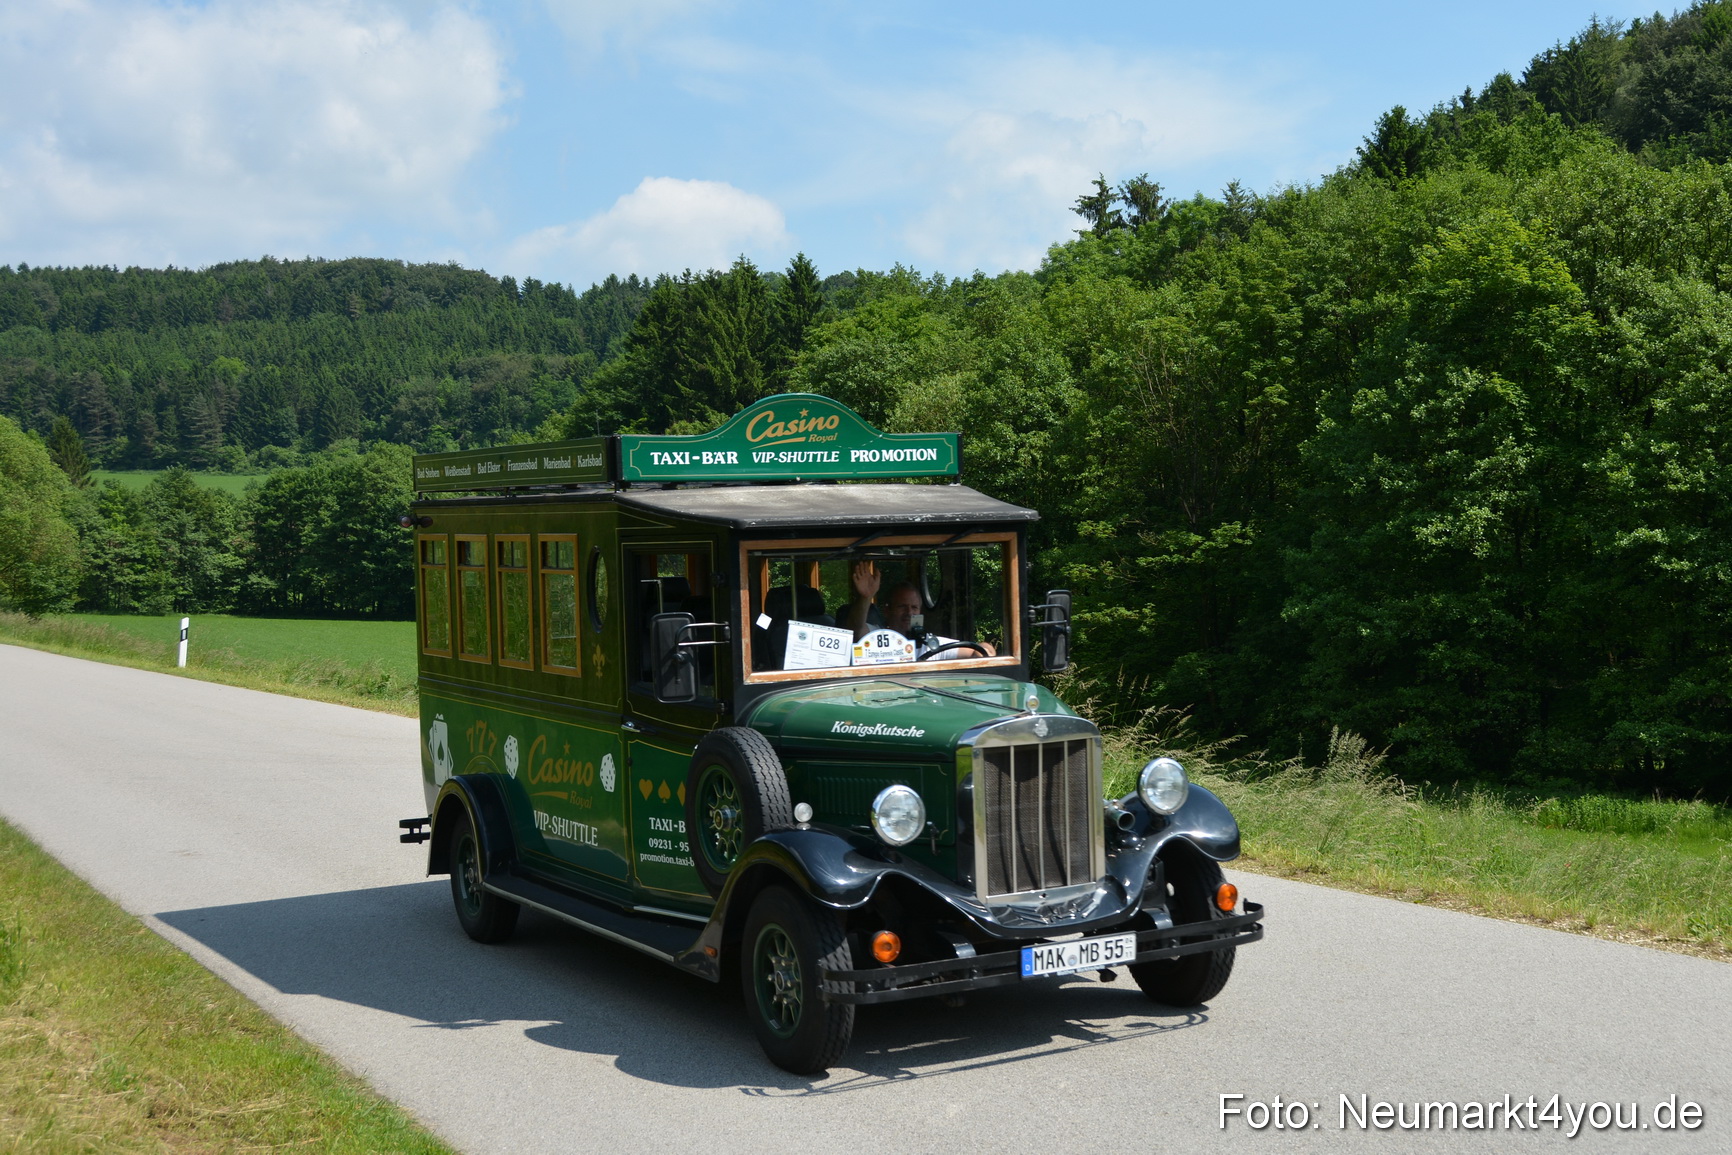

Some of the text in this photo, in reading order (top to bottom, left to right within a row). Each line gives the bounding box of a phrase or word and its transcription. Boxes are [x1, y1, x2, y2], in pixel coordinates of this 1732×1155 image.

[746, 408, 840, 442] Casino
[808, 433, 837, 443] Royal
[417, 468, 425, 478] Bad
[477, 462, 486, 474] Bad
[487, 461, 501, 473] Elster
[508, 458, 538, 471] Franzensbad
[543, 456, 571, 469] Marienbad
[577, 453, 602, 468] Karlsbad
[650, 451, 738, 465] TAXI-BÄR
[752, 451, 840, 463] VIP-SHUTTLE
[819, 637, 840, 650] 628
[877, 634, 889, 647] 85
[466, 720, 497, 756] 777
[528, 735, 594, 787] Casino
[570, 791, 592, 809] Royal
[534, 810, 598, 847] VIP-SHUTTLE
[649, 817, 686, 833] TAXI-B
[648, 838, 672, 850] 09231
[679, 841, 690, 852] 95
[640, 853, 695, 867] promotion.taxi-b
[1034, 947, 1066, 971] MAK
[1080, 943, 1099, 964] MB
[1104, 939, 1124, 960] 55
